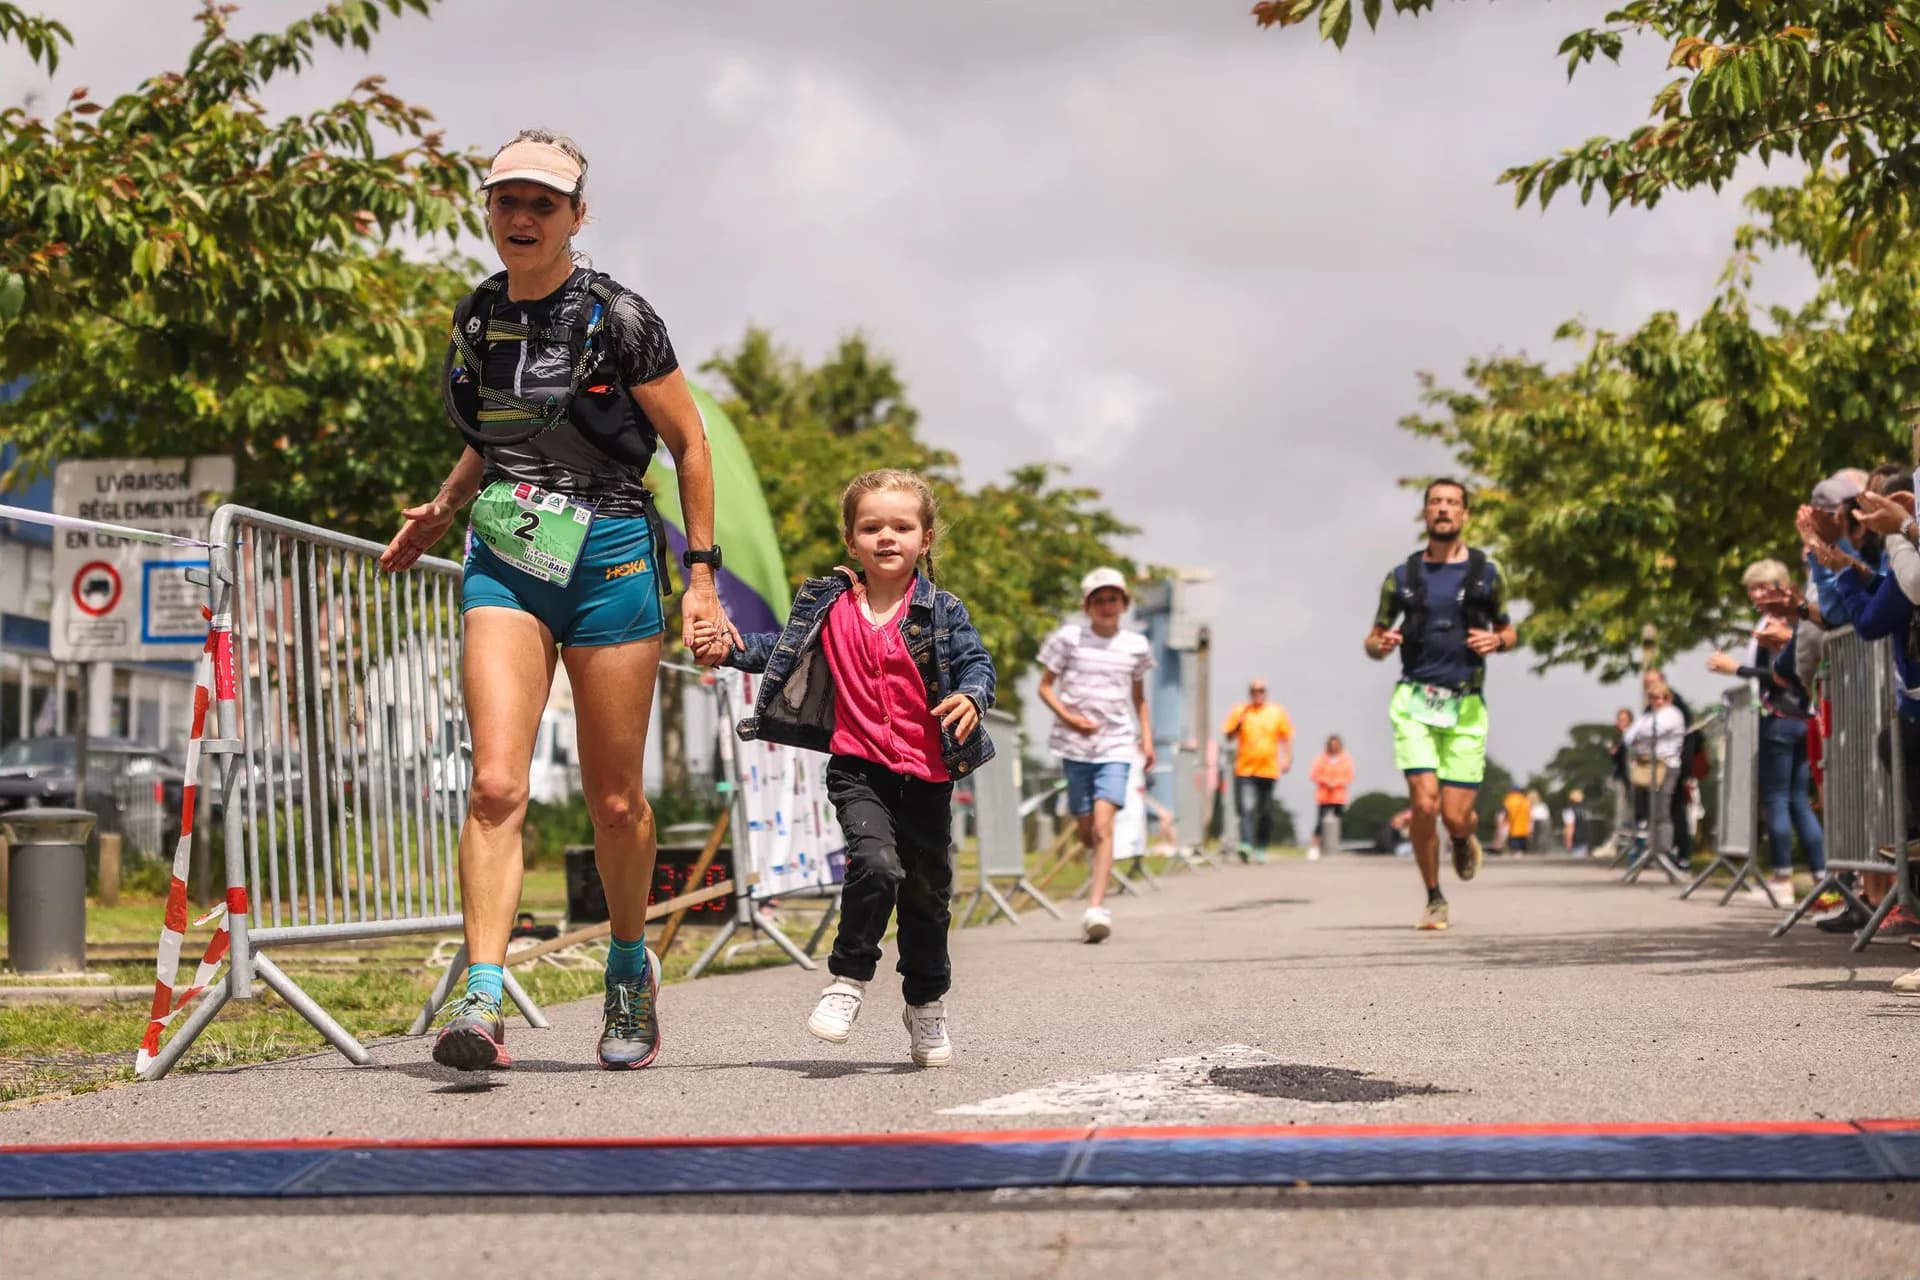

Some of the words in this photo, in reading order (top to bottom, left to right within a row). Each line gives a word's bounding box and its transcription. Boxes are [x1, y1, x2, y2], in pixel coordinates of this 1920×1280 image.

[96, 473, 190, 493] LIVRAISON
[513, 511, 540, 542] 2
[524, 552, 569, 575] ULTRABAIE
[605, 558, 647, 581] HOKA
